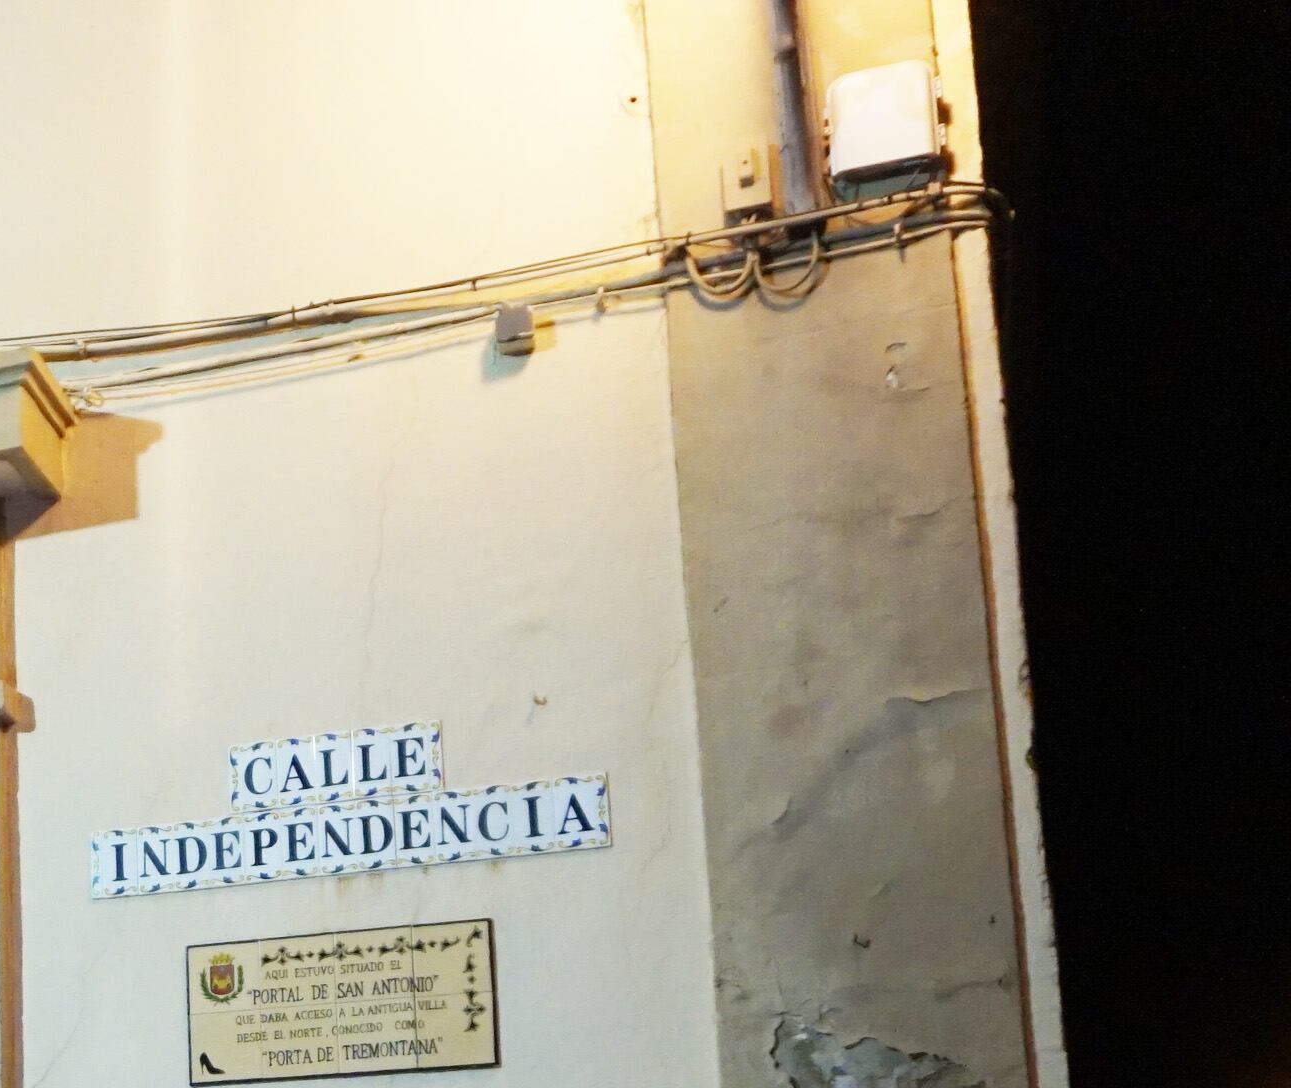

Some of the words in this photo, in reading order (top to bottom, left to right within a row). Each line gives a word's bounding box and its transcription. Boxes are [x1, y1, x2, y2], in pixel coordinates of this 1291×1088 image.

[244, 735, 428, 796] CALLE
[111, 791, 596, 883] INDEPENDENCIA
[294, 965, 334, 978] ESTUVO
[339, 960, 384, 975] SITUADO
[311, 983, 329, 1000] DE
[337, 981, 364, 999] SAN
[235, 1014, 256, 1026] QUE
[260, 1012, 289, 1024] DABA
[294, 1008, 333, 1021] ACCESO
[338, 1007, 347, 1018] A
[352, 1006, 365, 1017] LA
[367, 1001, 414, 1016] ANTIGUA
[417, 999, 448, 1011] VILLA
[236, 1031, 269, 1043] DESDE
[331, 1022, 383, 1036] CONOCIDO
[394, 1019, 426, 1031] COMO
[317, 1046, 335, 1063] DE
